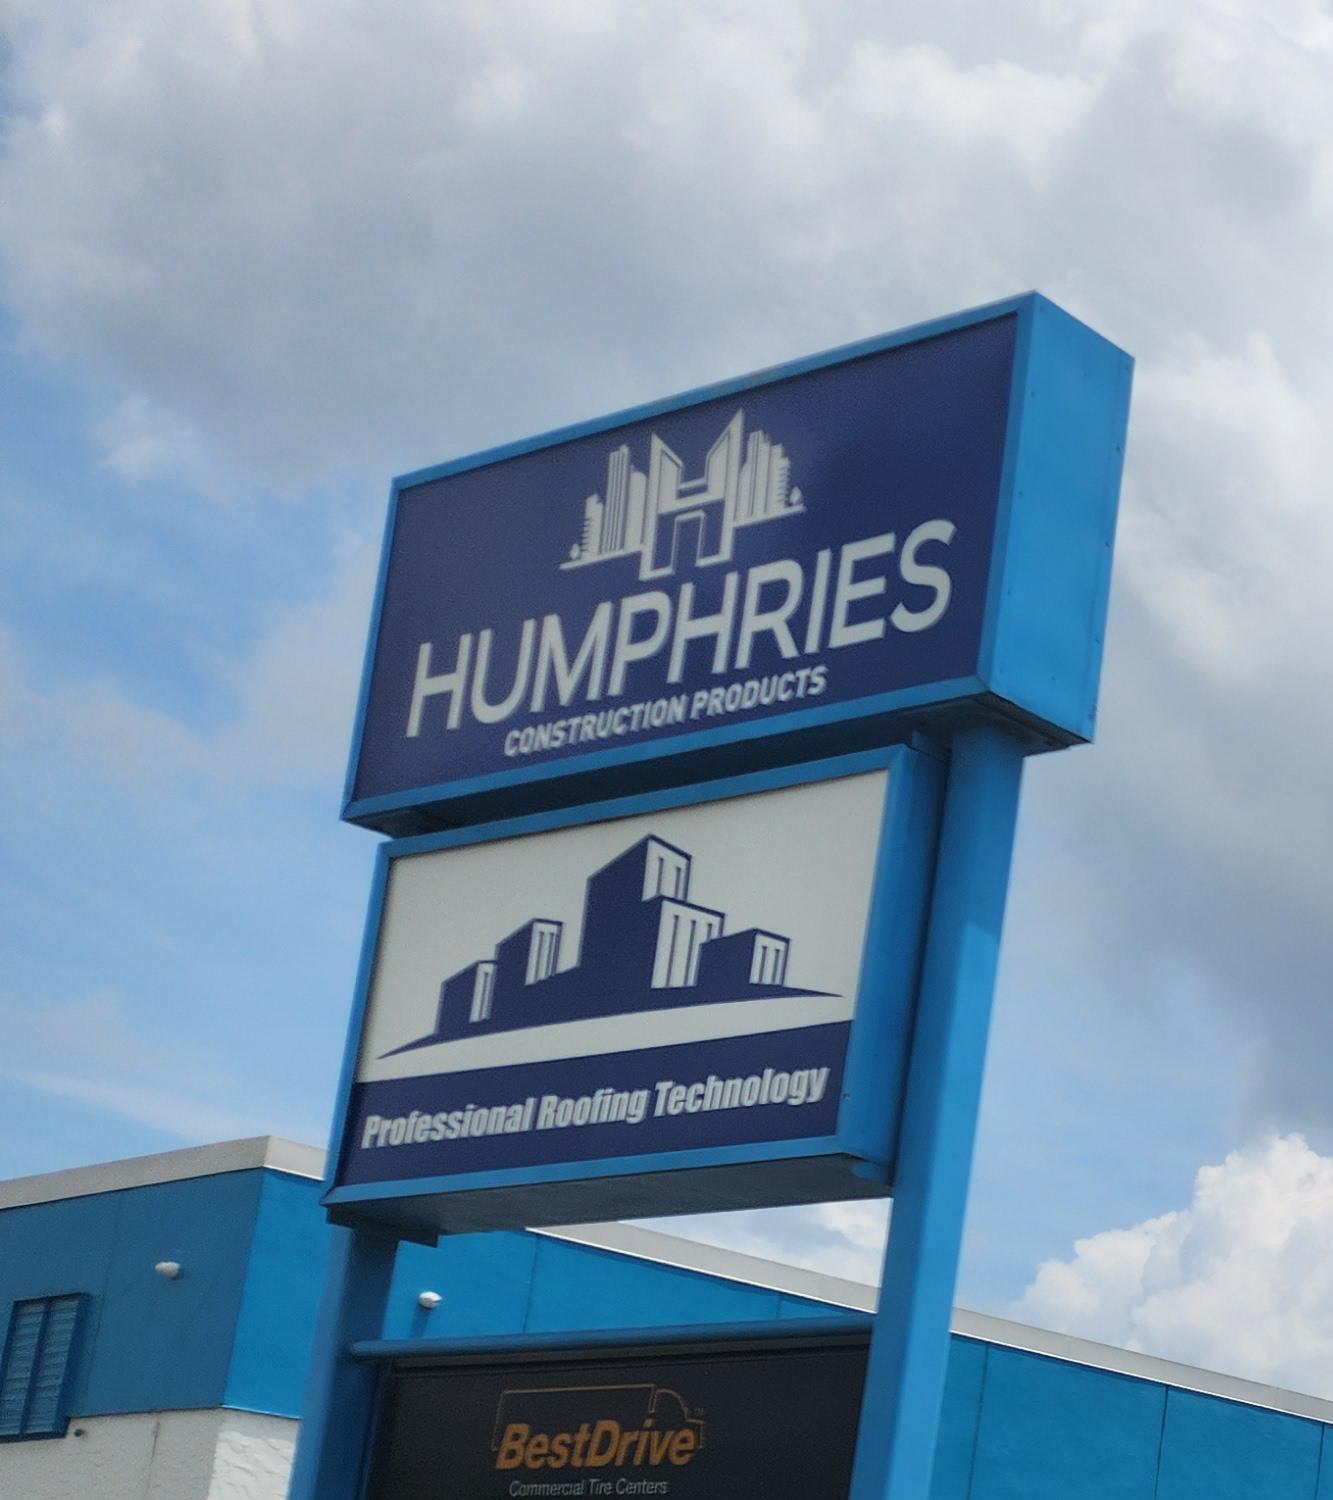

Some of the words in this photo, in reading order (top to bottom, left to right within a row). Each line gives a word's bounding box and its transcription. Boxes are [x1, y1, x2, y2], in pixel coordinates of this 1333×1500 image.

[405, 518, 958, 738] HUMPHRIES
[503, 694, 686, 758] CONSTRUCTION
[691, 665, 828, 720] PRODUCTS
[361, 1097, 534, 1149] Professional
[538, 1087, 649, 1130] Roofing
[654, 1065, 829, 1118] Technology
[496, 1418, 696, 1470] BestDrive
[509, 1479, 585, 1497] Commercial
[589, 1478, 613, 1495] Tire
[616, 1477, 669, 1495] Centers
